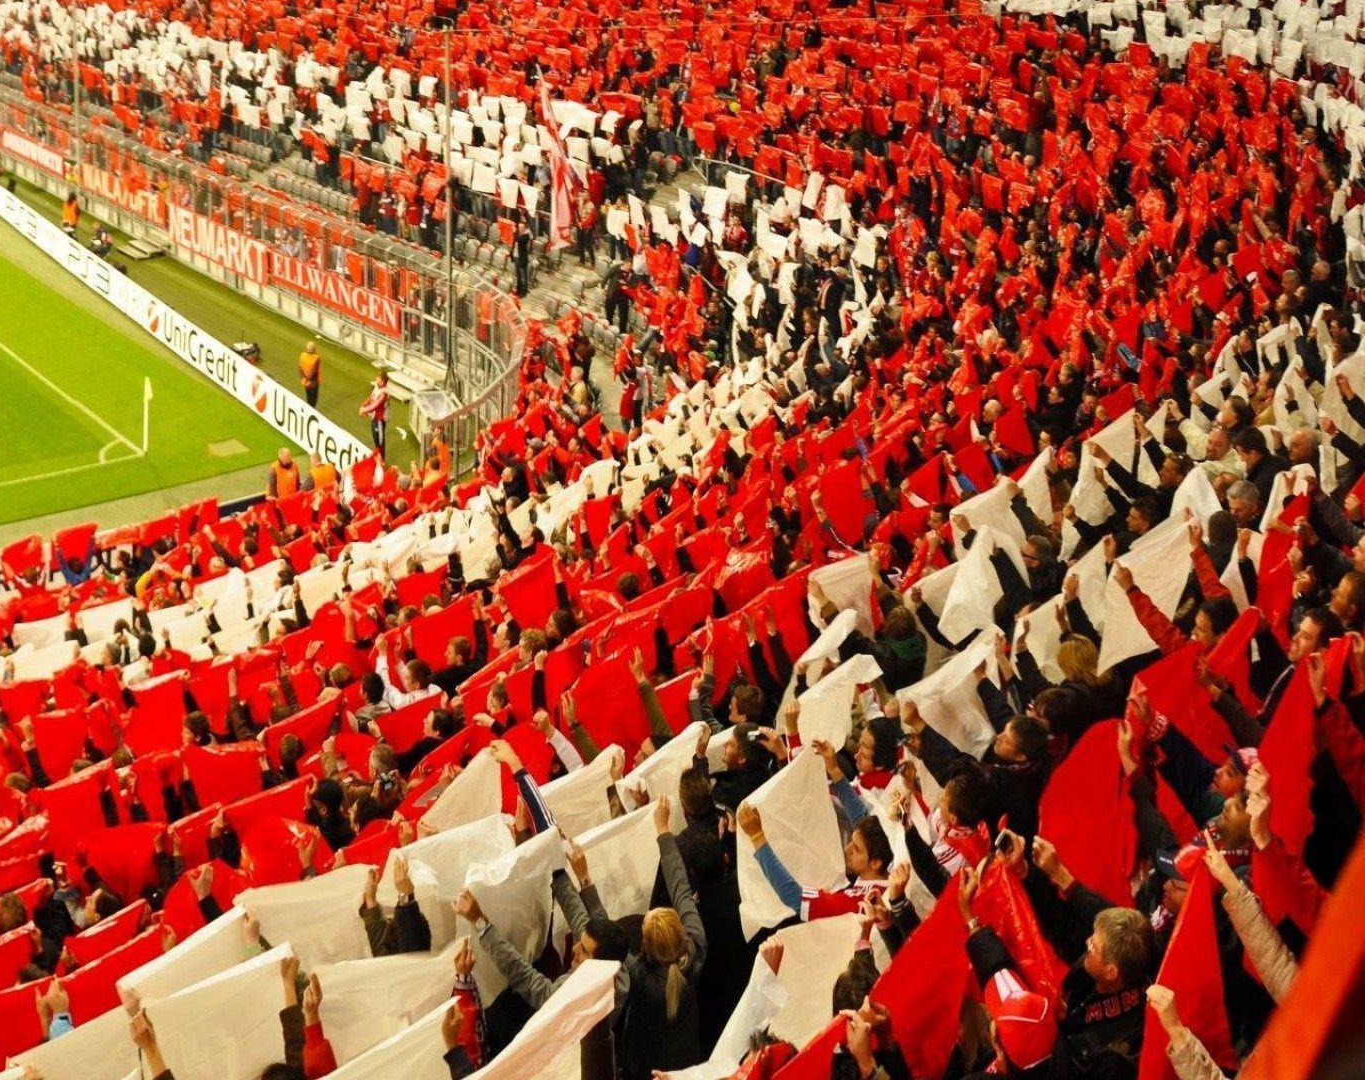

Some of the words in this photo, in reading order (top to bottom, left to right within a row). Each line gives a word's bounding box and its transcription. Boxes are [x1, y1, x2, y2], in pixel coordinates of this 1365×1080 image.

[169, 203, 267, 284] NEUMARKT
[273, 251, 399, 329] ELLWANGEN
[162, 309, 238, 392] UniCredit
[273, 387, 367, 471] UniCredi
